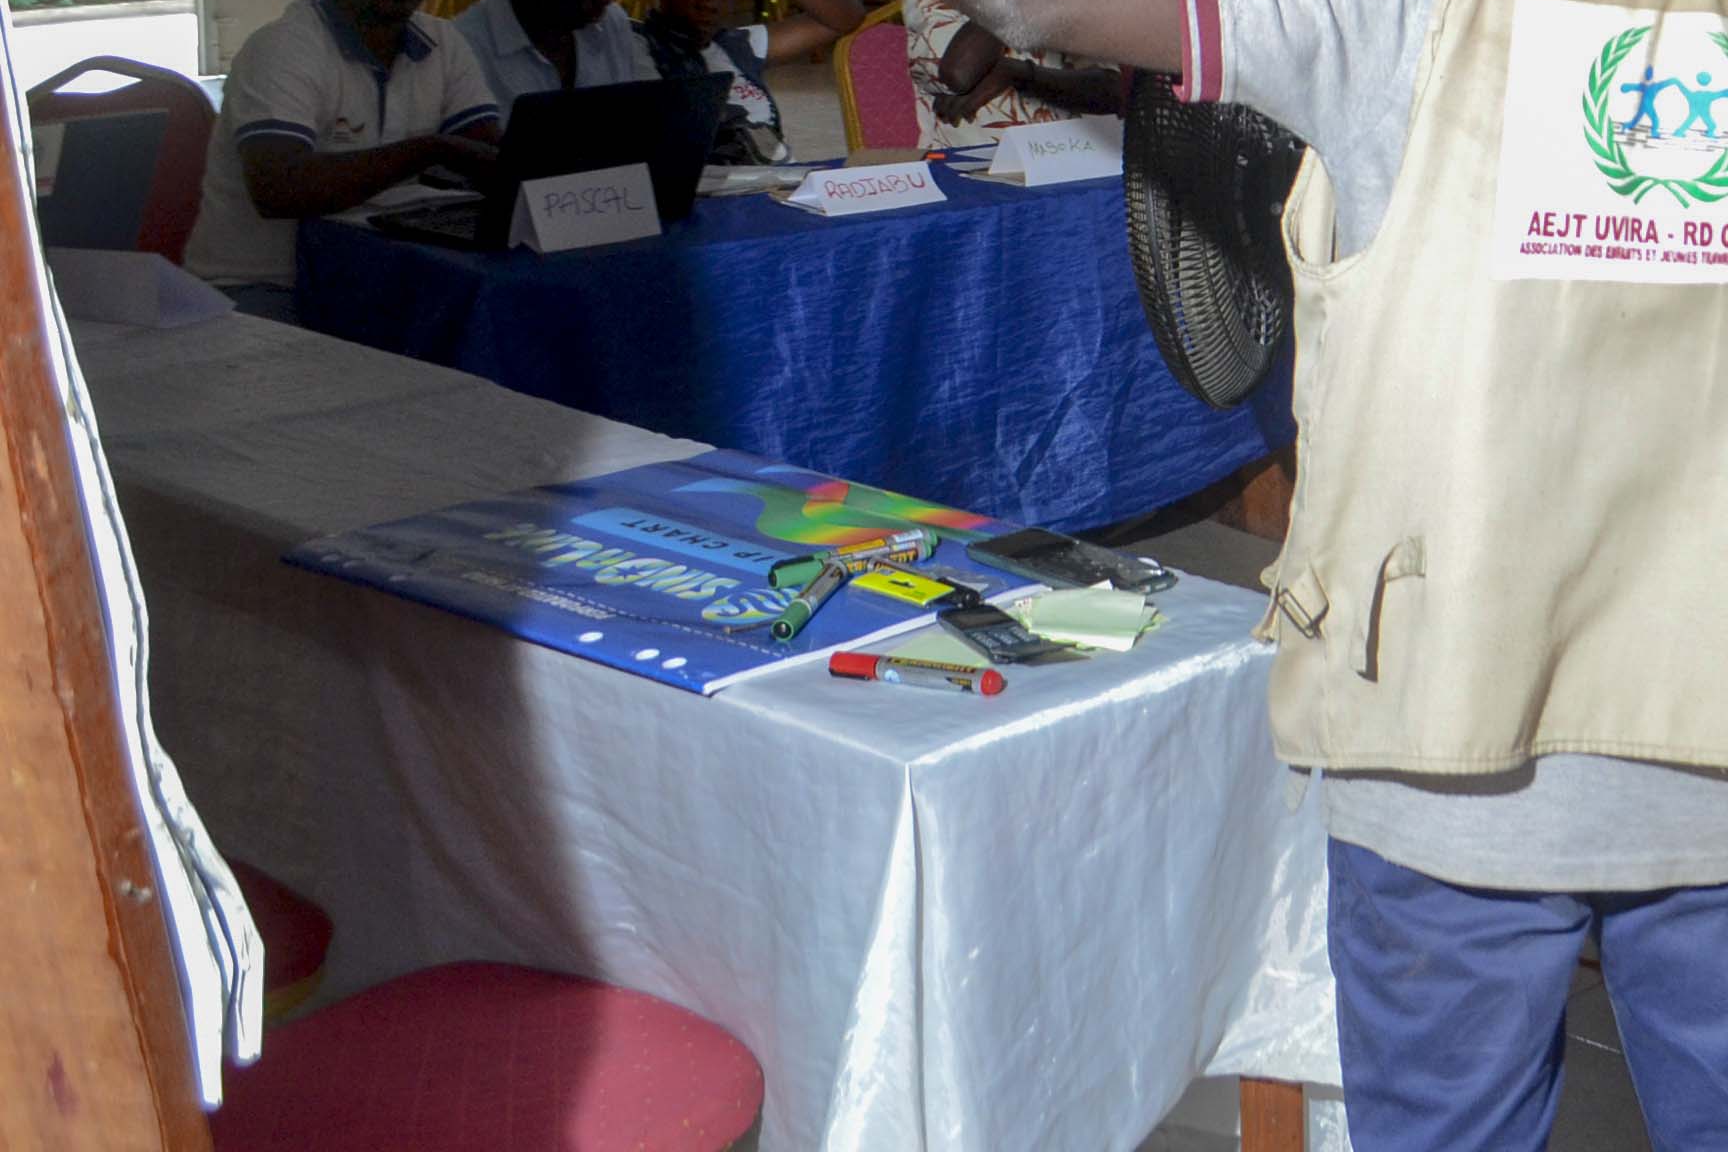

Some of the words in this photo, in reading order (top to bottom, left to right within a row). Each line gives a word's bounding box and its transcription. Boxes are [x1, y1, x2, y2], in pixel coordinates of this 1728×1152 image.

[543, 184, 642, 217] PASCAL
[1528, 211, 1587, 238] AEJT
[1595, 215, 1659, 244] UVIRA
[1683, 221, 1713, 246] RD
[1519, 242, 1582, 256] ASSOCIATION
[1585, 245, 1602, 258] DES
[1645, 249, 1656, 261] ET
[621, 518, 730, 550] CHART
